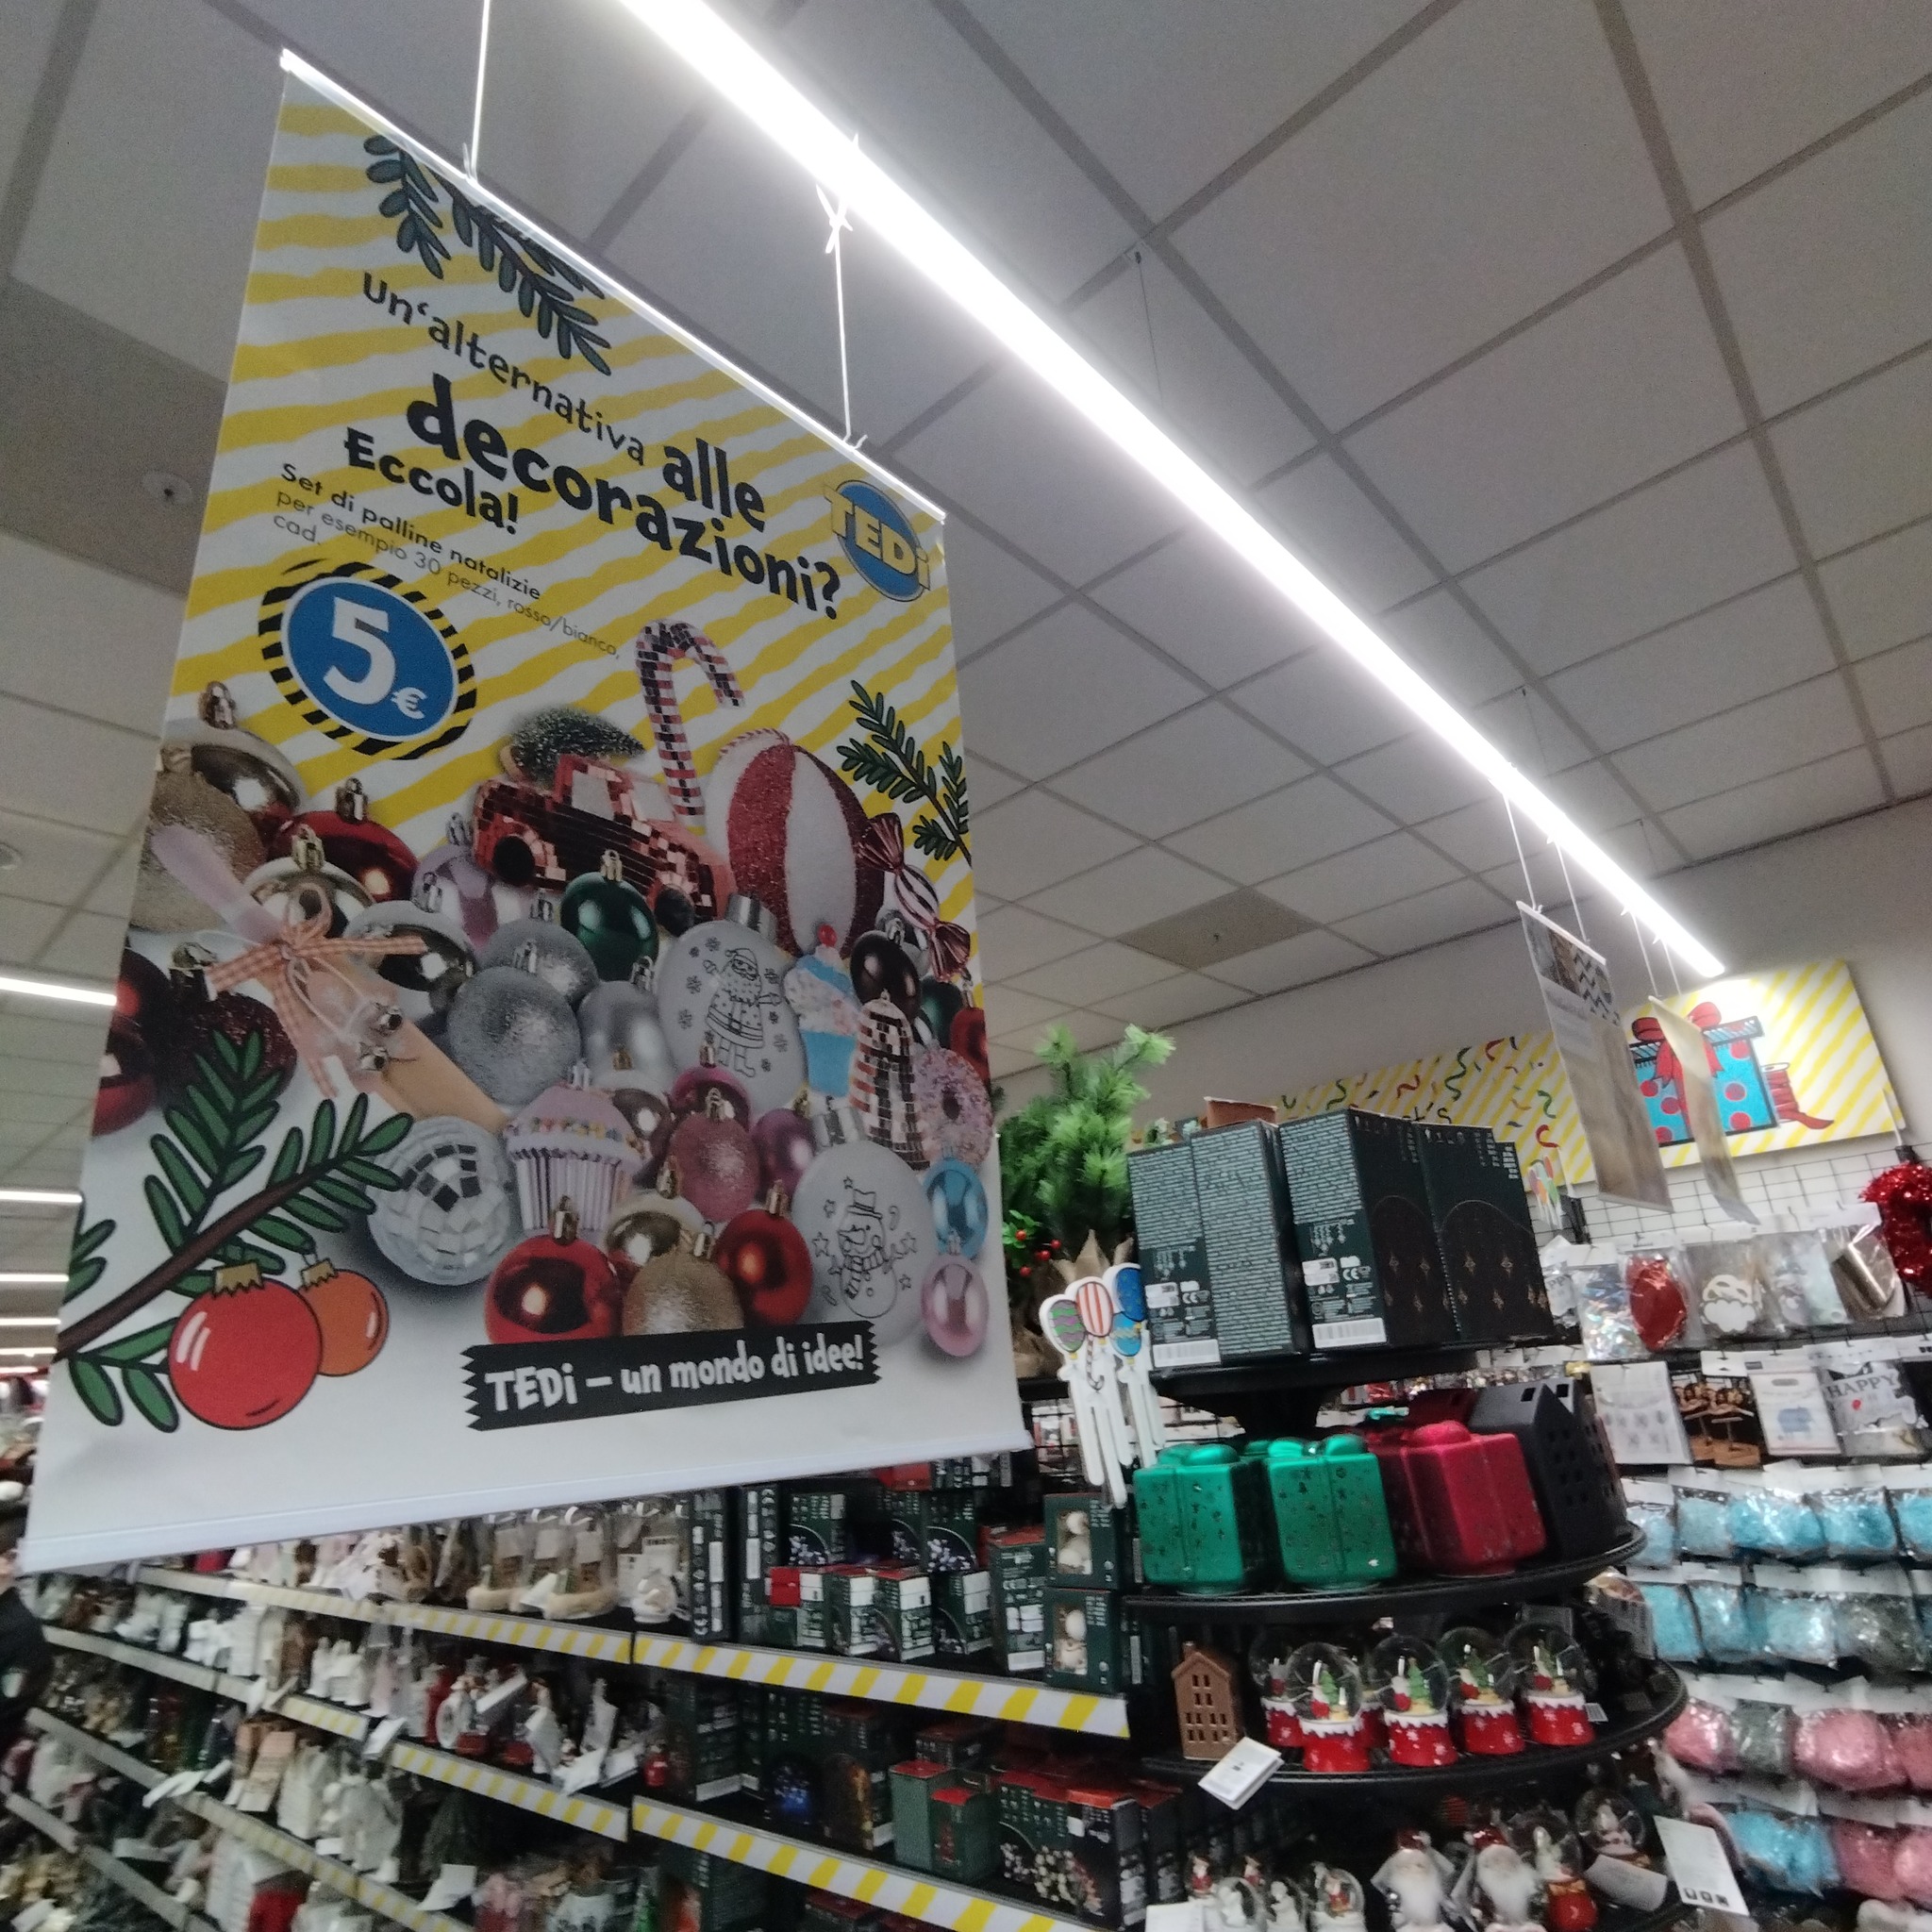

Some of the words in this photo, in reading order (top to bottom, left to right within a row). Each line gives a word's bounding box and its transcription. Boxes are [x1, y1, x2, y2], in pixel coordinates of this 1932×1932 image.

[273, 514, 322, 546] cad.
[280, 462, 324, 496] Set
[331, 490, 356, 512] di
[361, 507, 442, 554] palline
[449, 548, 541, 600] natalizie
[342, 426, 519, 535] Eccola!
[406, 372, 841, 620] decorazioni?
[662, 437, 765, 533] alle
[276, 490, 315, 516] per
[321, 512, 408, 560] esempio
[412, 551, 442, 575] 30
[447, 570, 502, 607] pezzi,
[507, 598, 621, 660] rosso/bianco,
[824, 481, 931, 591] TEDi
[484, 1362, 579, 1412] TEDi
[620, 1363, 662, 1395] un
[668, 1339, 766, 1390] mondo
[770, 1335, 799, 1379] di
[801, 1331, 865, 1374] idee!
[1826, 1374, 1896, 1397] HAPPY
